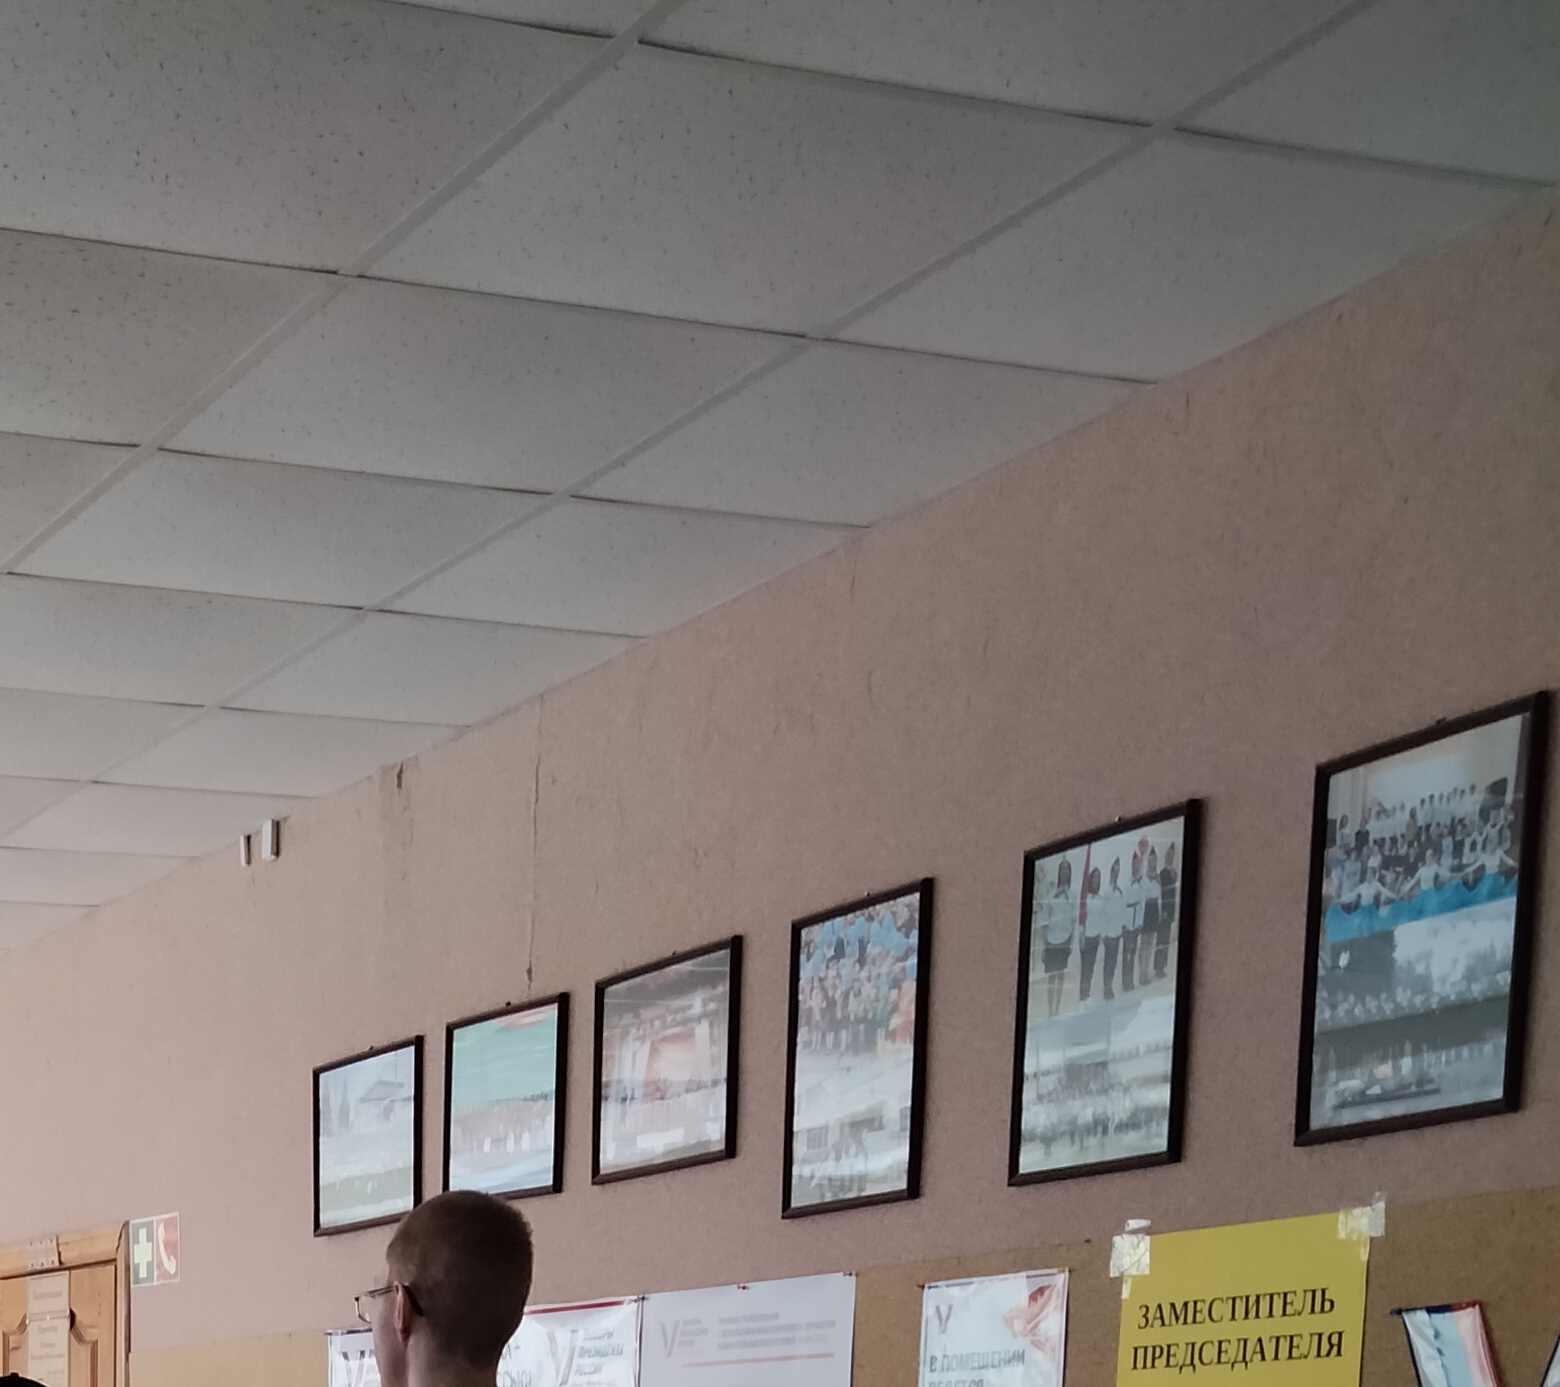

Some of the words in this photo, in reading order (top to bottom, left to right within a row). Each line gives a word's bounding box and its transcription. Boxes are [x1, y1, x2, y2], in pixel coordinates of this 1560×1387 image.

[1137, 1287, 1336, 1330] ЗАМЕСТИТЕЛЬ
[941, 1349, 1026, 1373] ПОМЕЩЕНИИ
[1131, 1330, 1345, 1374] ПРЕДСЕДАТЕЛЯ
